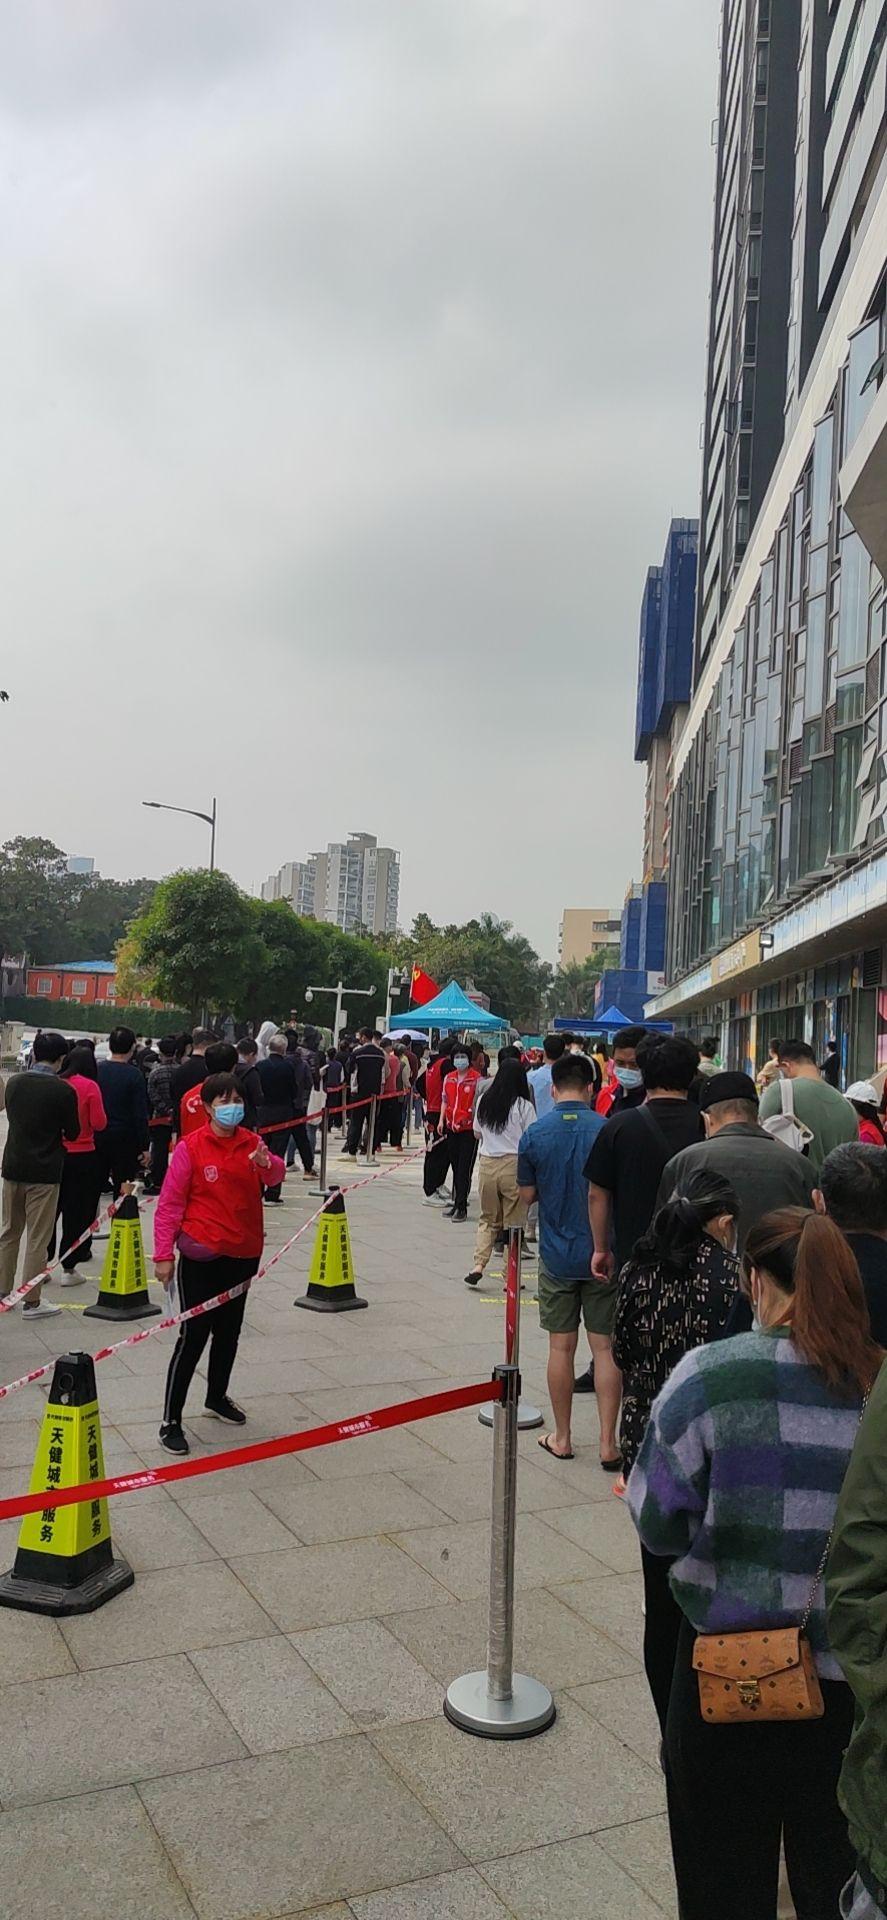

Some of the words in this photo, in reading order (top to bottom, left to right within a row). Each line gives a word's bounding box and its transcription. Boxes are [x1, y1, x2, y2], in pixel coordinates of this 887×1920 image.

[40, 1427, 64, 1543] 天健城服务
[87, 1425, 102, 1537] 天健城服务
